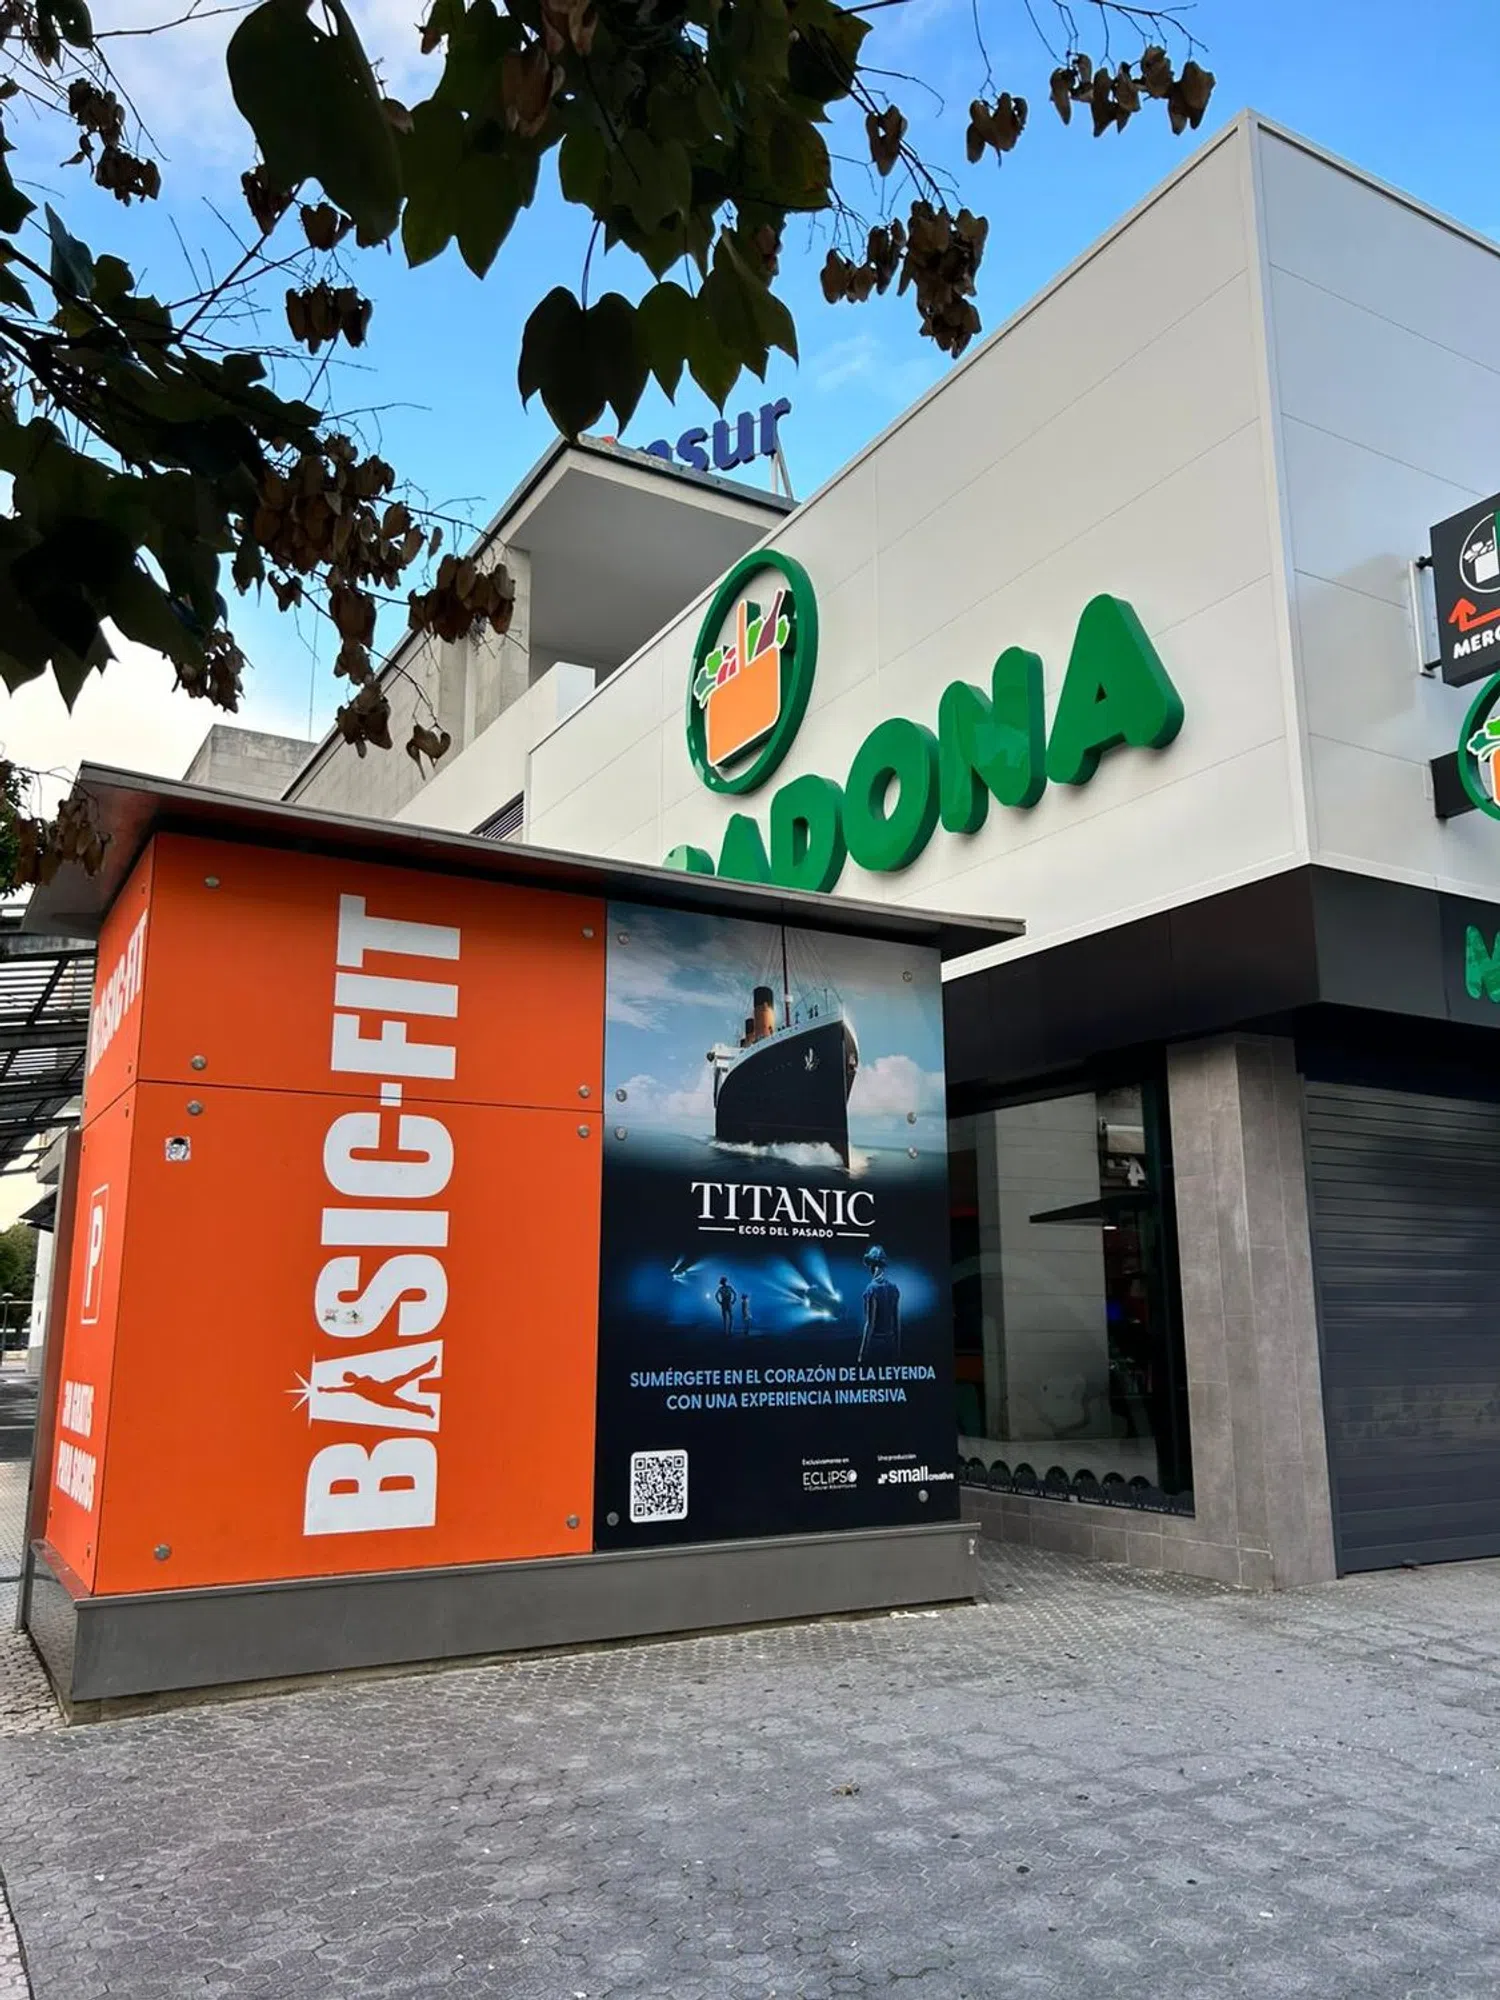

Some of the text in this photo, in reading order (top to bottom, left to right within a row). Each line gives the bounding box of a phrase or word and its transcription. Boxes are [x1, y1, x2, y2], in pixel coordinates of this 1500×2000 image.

[662, 593, 1185, 894] ADONA
[304, 893, 460, 1535] BASIC-FIT
[690, 1181, 876, 1227] TITANIC
[738, 1225, 834, 1238] ECOS DEL PASADO
[630, 1364, 936, 1387] SUMÉRGETE EN EL CORAZÓN DE LA LEYENDA
[666, 1387, 907, 1410] CON UNA EXPERIENCIA INMERSIVA
